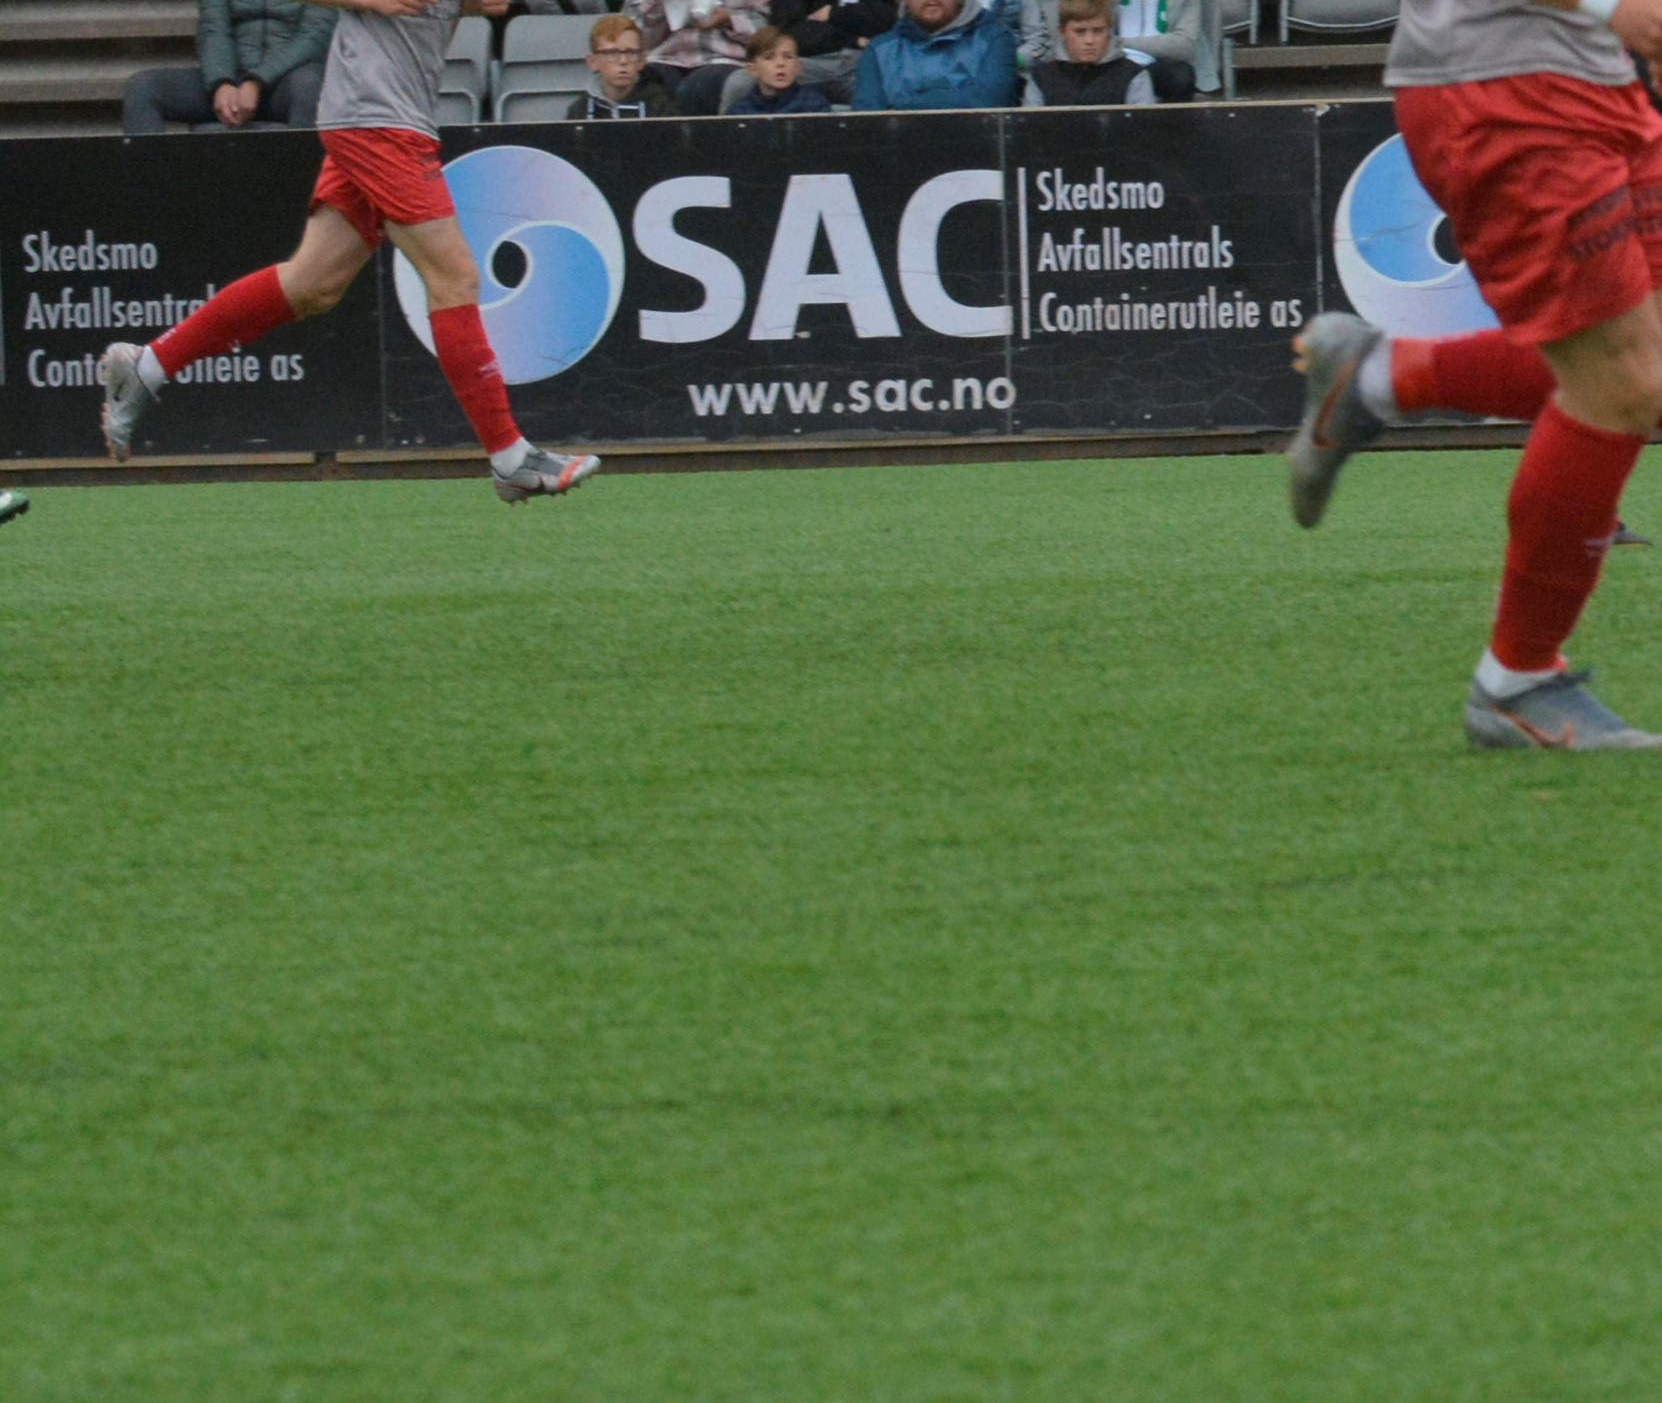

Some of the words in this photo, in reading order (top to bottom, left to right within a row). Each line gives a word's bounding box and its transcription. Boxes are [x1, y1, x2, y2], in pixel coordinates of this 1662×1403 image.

[1036, 167, 1165, 212] Skedsmo
[22, 229, 159, 273] Skedsmo
[632, 169, 1013, 344] SAC
[1037, 225, 1234, 273] Avfallsentrals
[24, 284, 216, 330] Avfallsentr
[1039, 286, 1261, 333] Containerutleie
[1270, 296, 1303, 329] as
[270, 353, 305, 382] as
[687, 376, 1017, 418] www.sac.no
